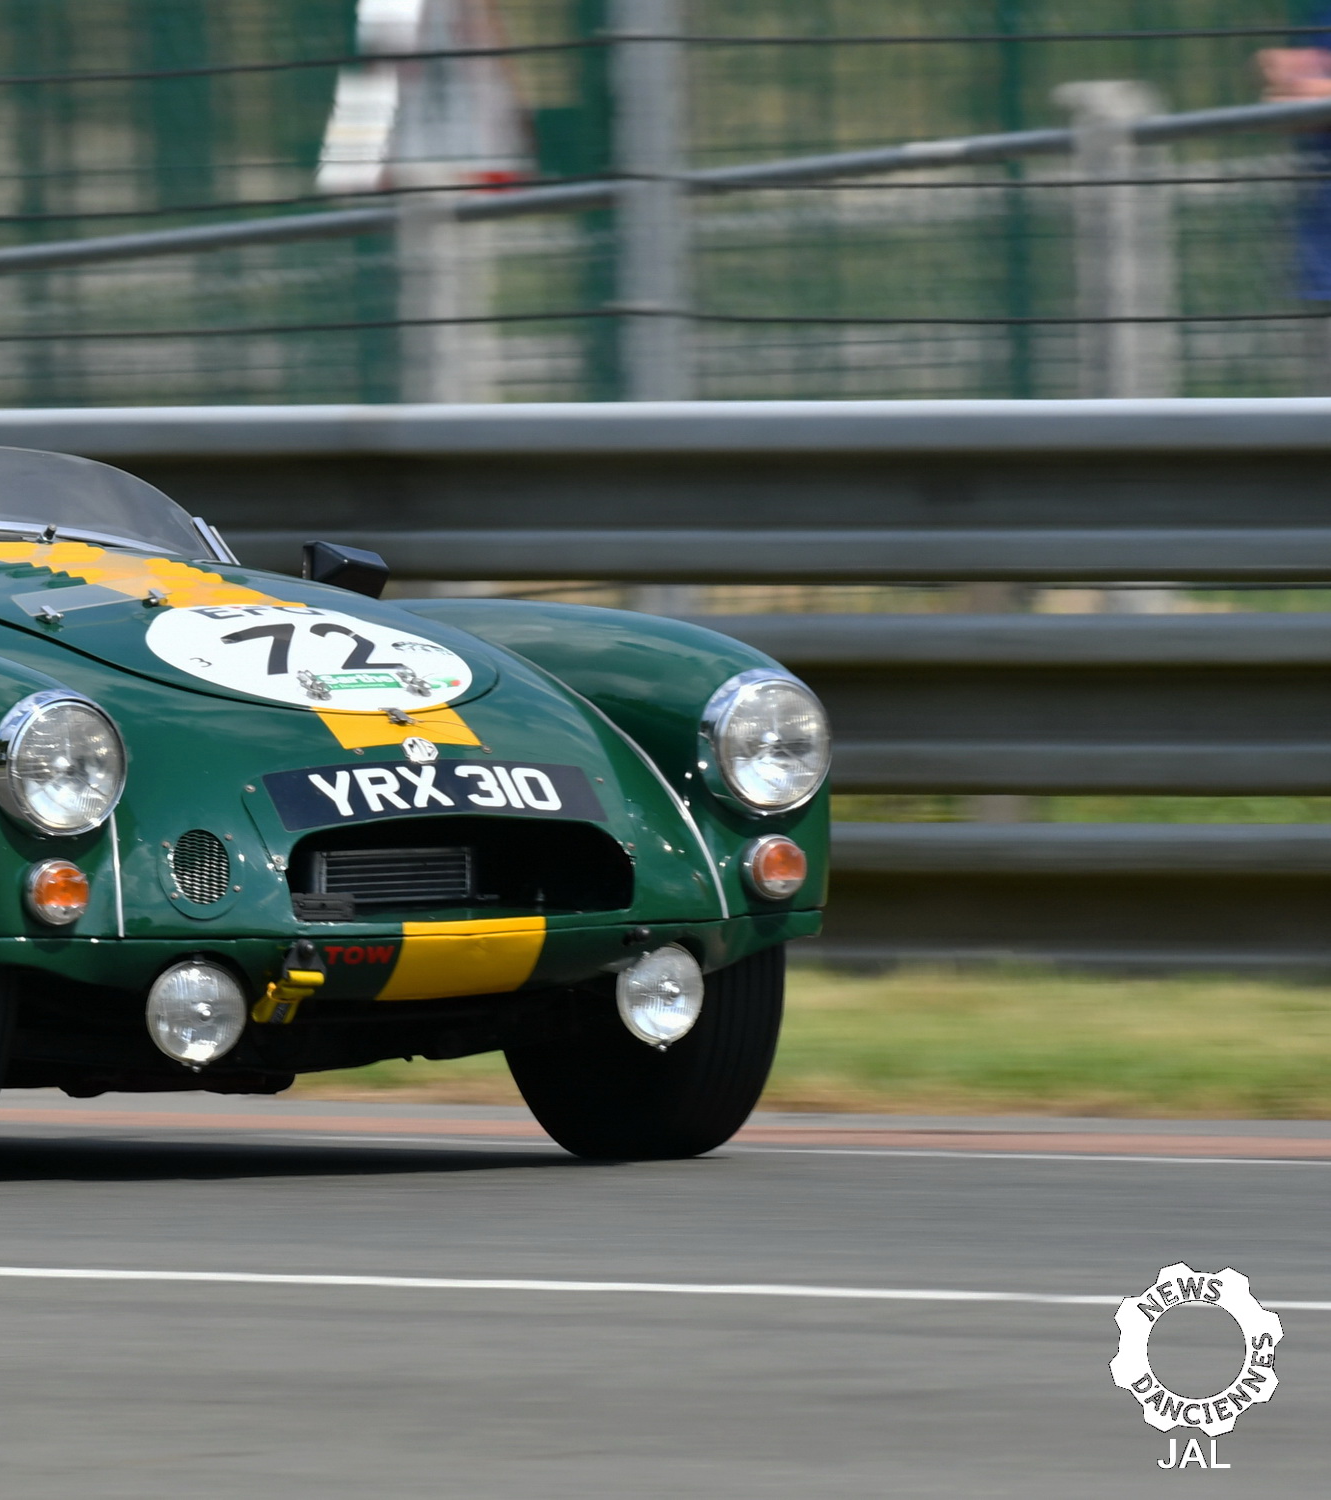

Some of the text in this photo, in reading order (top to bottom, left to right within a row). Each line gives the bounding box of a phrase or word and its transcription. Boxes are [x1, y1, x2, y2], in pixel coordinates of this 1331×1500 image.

[188, 605, 326, 620] EFG
[220, 622, 409, 676] 72
[188, 656, 214, 669] 3
[308, 765, 562, 817] YRX 310
[323, 945, 395, 965] TOW
